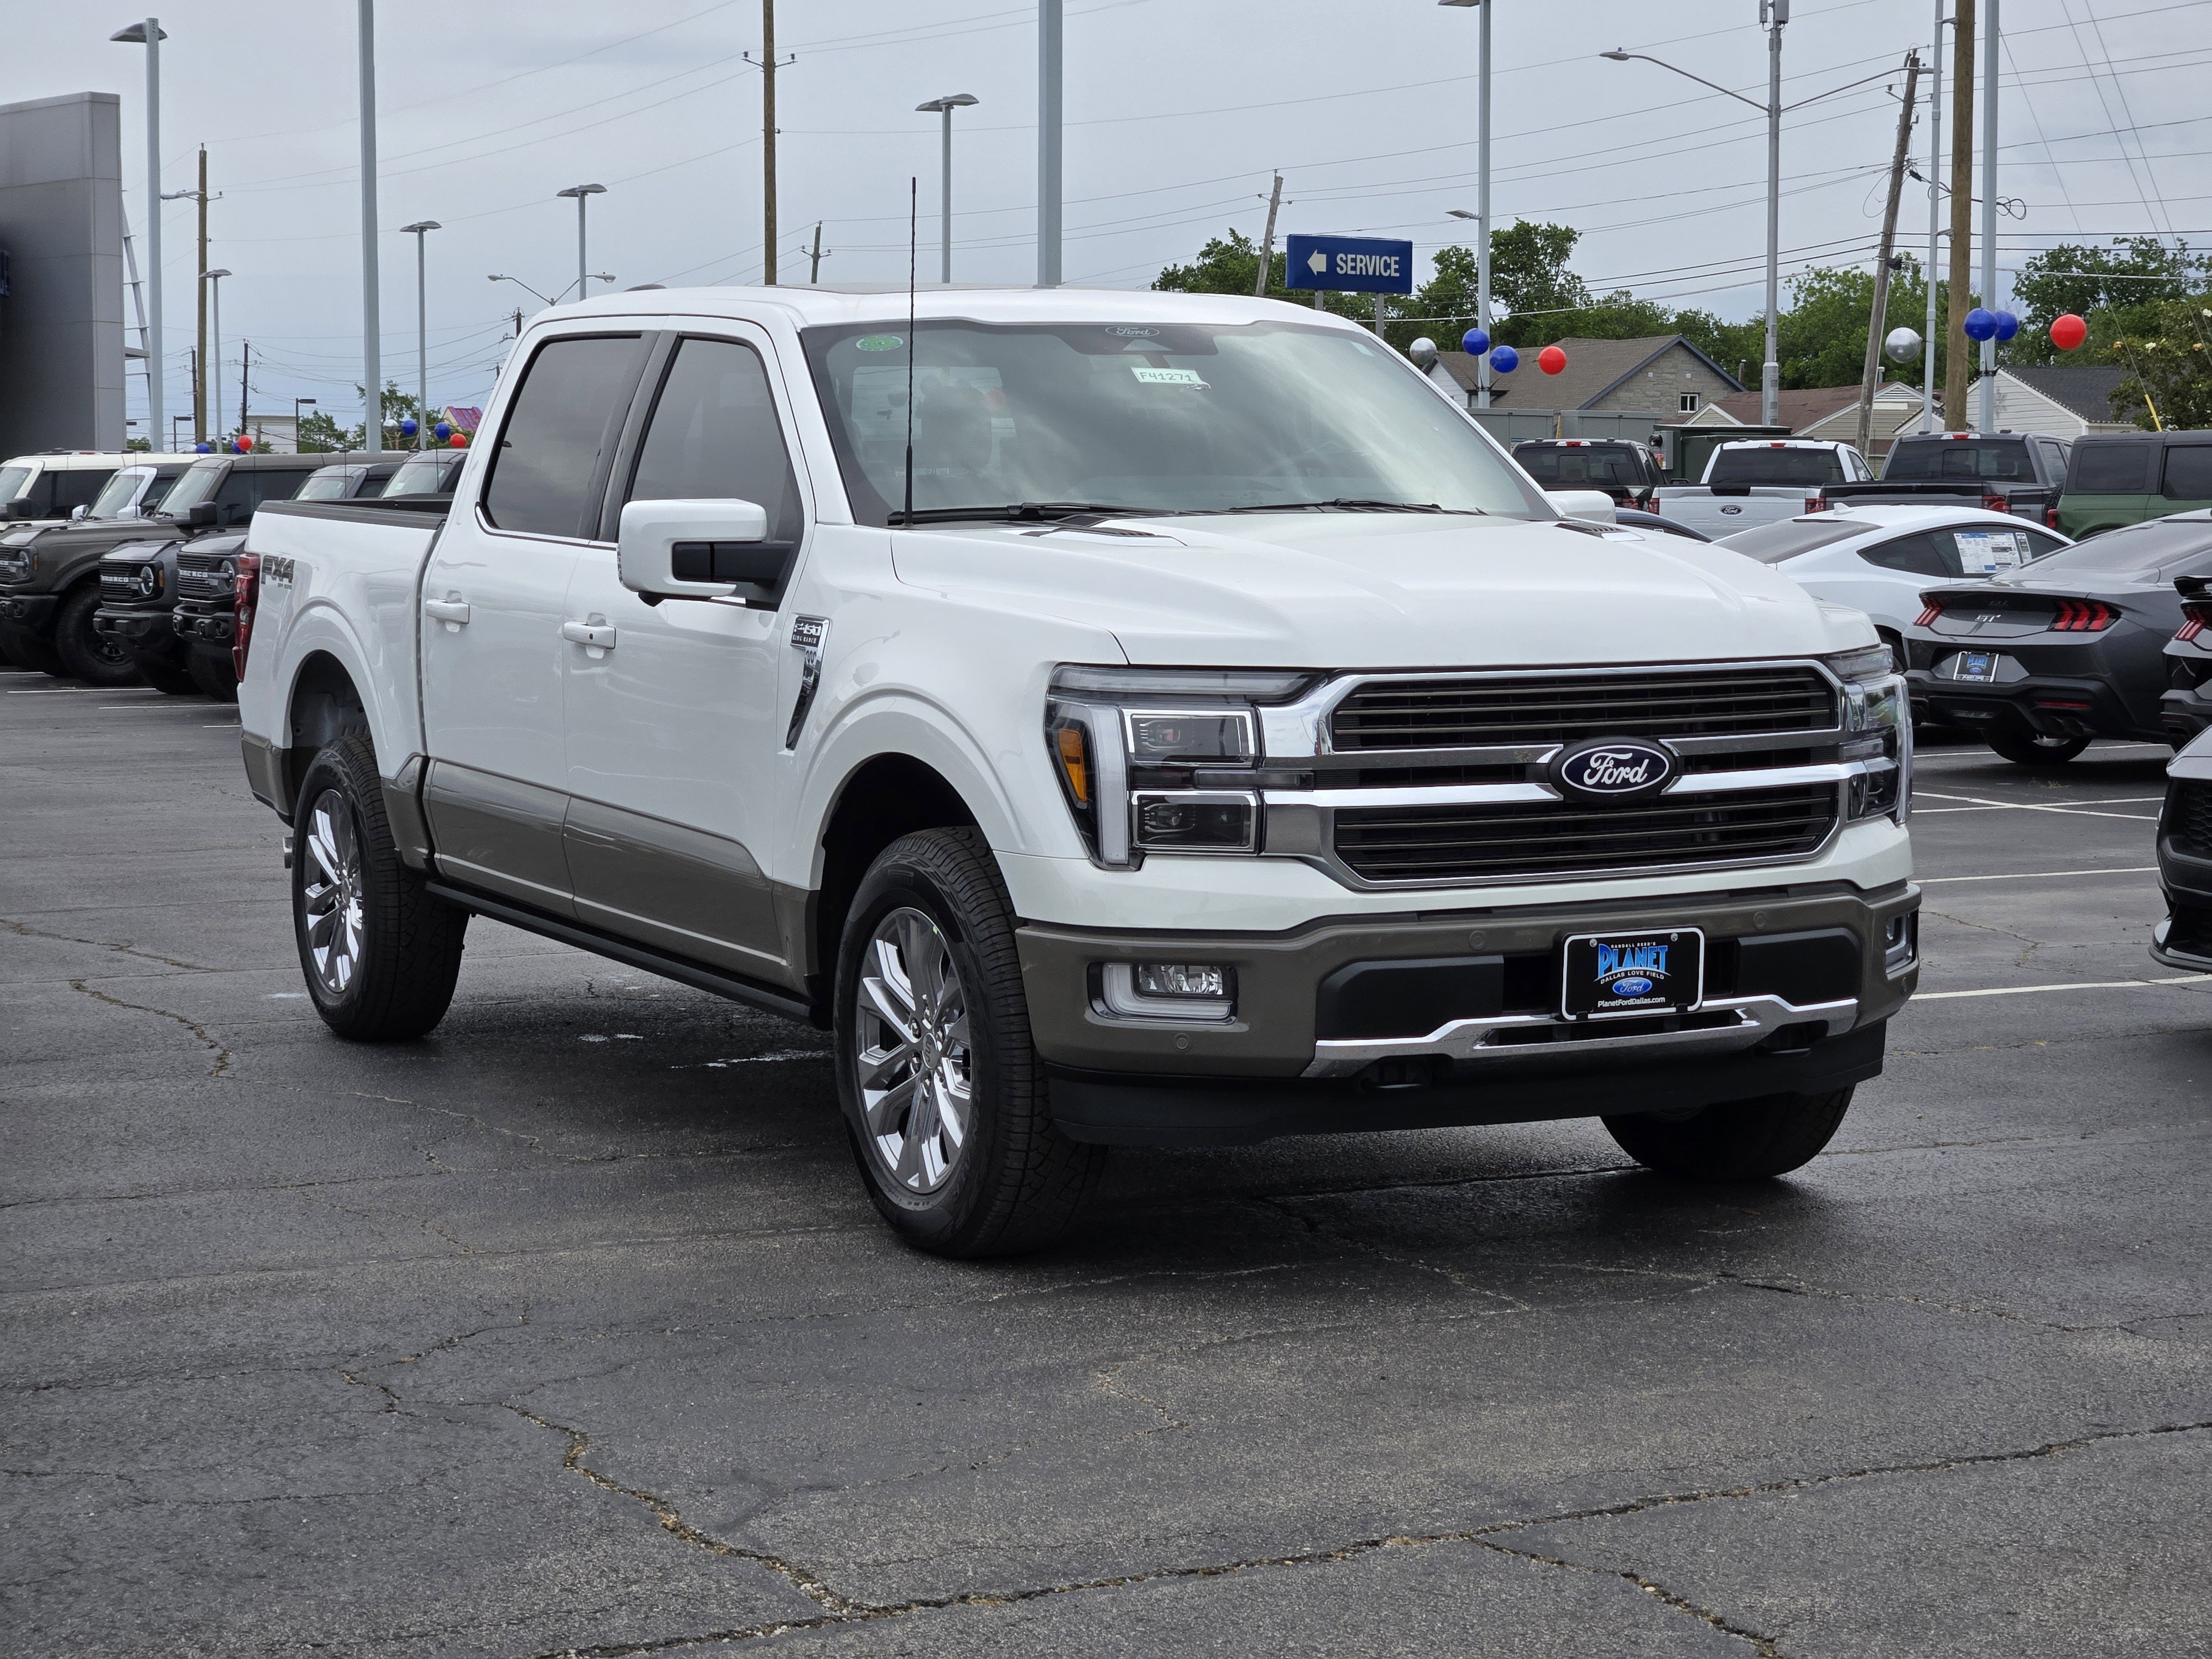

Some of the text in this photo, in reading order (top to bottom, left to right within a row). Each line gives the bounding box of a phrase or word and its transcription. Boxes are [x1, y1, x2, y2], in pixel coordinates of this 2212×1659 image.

[1336, 253, 1400, 277] SERVICE
[1116, 327, 1151, 336] Ford
[1139, 372, 1196, 382] F41271
[260, 555, 295, 585] FX4
[1583, 752, 1649, 785] Ford
[1598, 943, 1668, 978] PLANET
[1600, 972, 1625, 984] DALLAS
[1646, 971, 1665, 979] FIELD
[1620, 981, 1644, 993] Ford
[1598, 997, 1666, 1008] PlanetFordDallas.com
